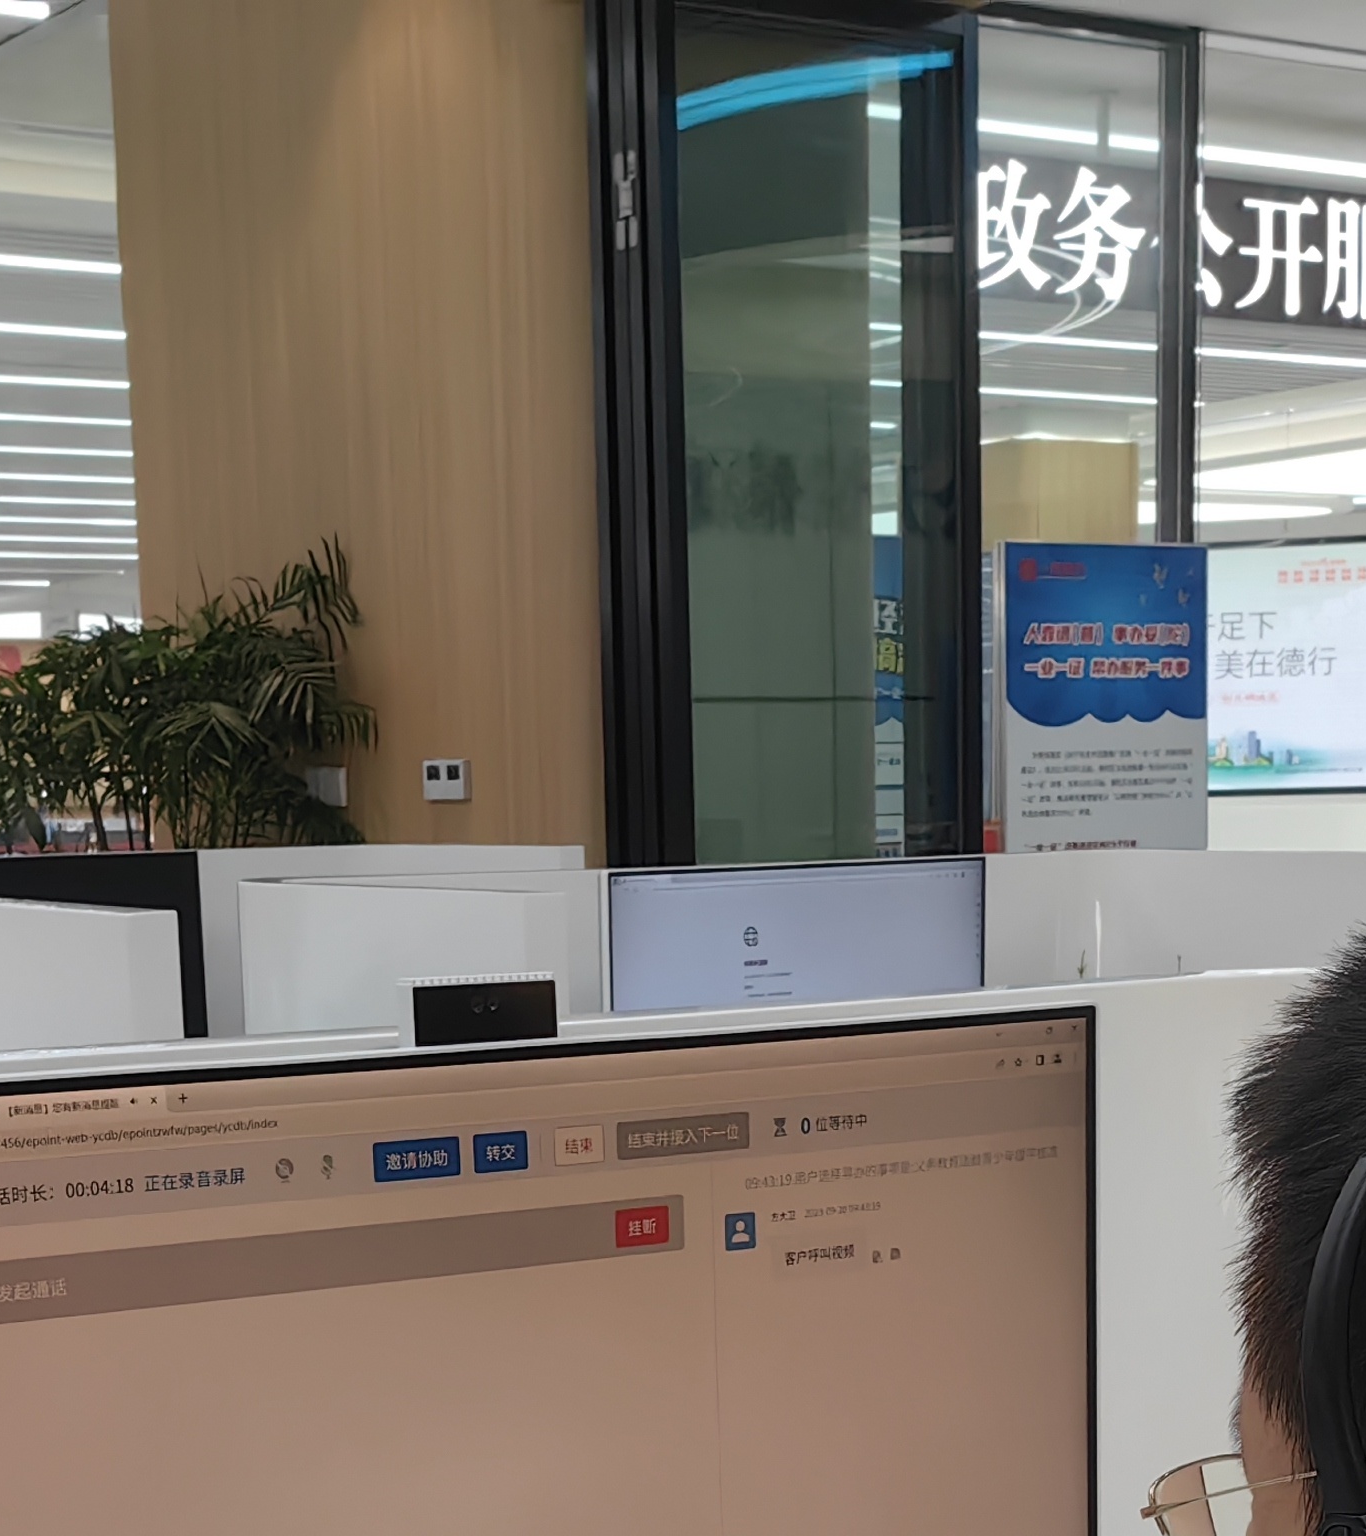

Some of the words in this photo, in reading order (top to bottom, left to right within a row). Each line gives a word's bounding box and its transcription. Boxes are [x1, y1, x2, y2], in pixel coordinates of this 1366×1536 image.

[1215, 646, 1338, 680] 美在德行
[801, 1117, 811, 1134] 0
[485, 1143, 516, 1162] 转交
[564, 1137, 594, 1155] 结束
[385, 1149, 449, 1172] 邀请协助
[144, 1166, 246, 1193] 正在录音录屏
[627, 1218, 656, 1237] 挂断
